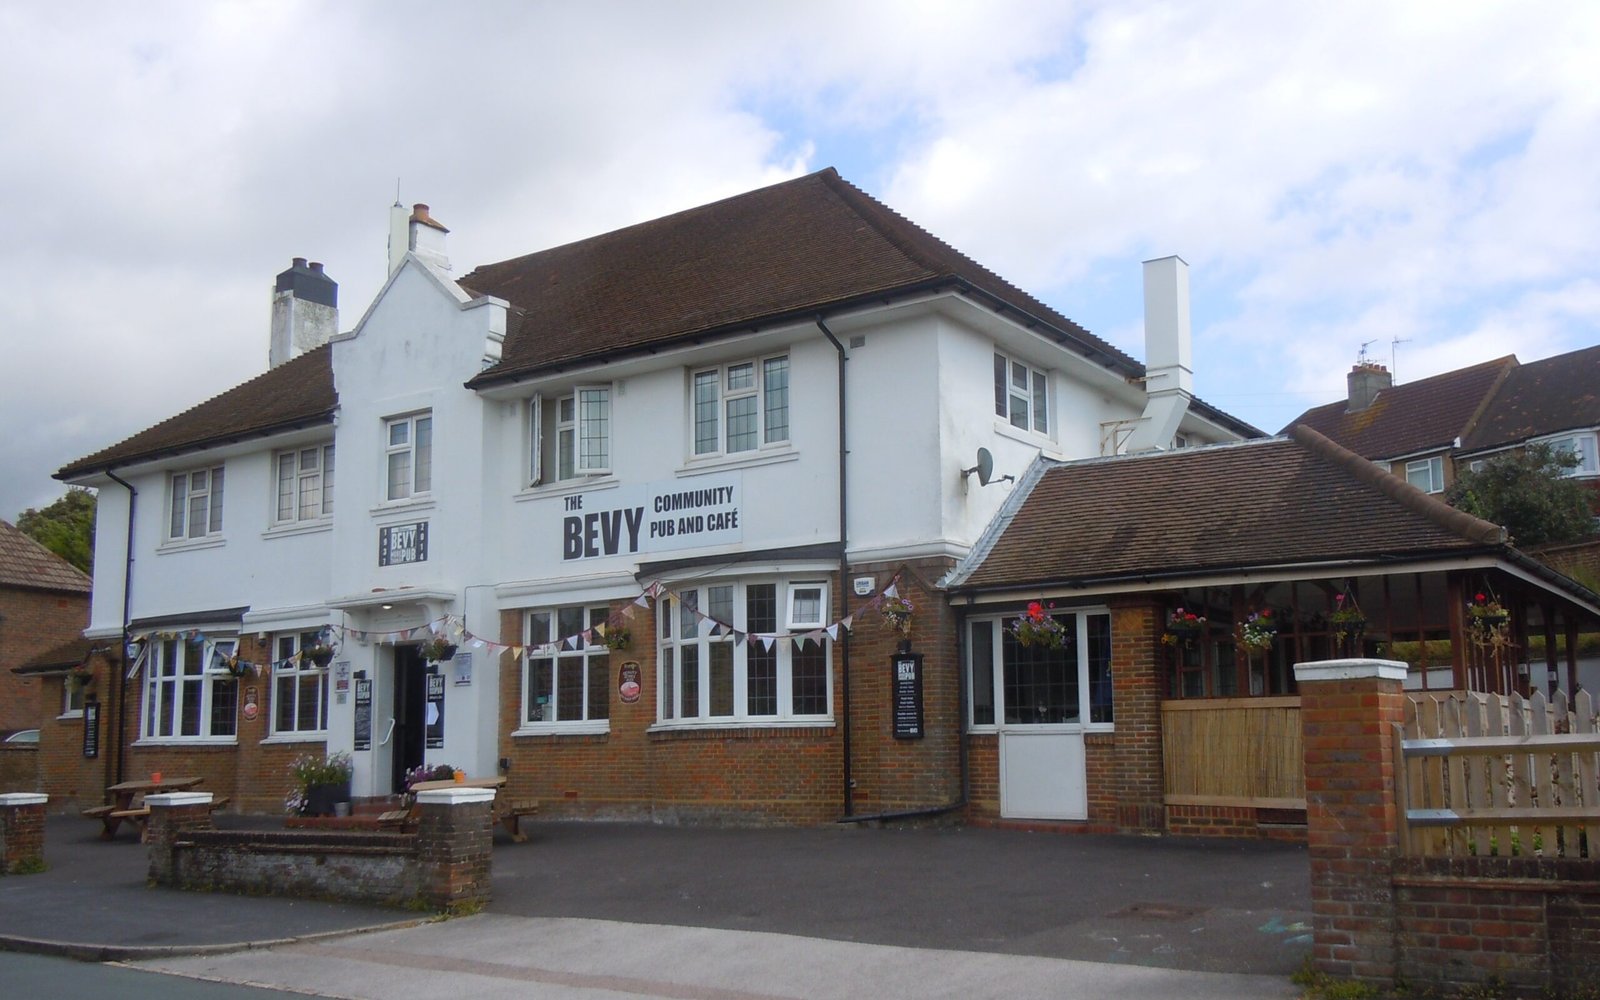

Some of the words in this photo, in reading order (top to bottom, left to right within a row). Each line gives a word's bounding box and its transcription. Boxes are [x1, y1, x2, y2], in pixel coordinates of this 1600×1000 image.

[564, 495, 583, 512] THE
[654, 486, 734, 513] COMMUNITY
[563, 507, 645, 561] BEVY
[650, 519, 675, 538] PUB
[678, 515, 704, 535] AND
[707, 508, 738, 531] CAFÉ
[391, 530, 416, 550] BEVY
[401, 548, 416, 561] PUB
